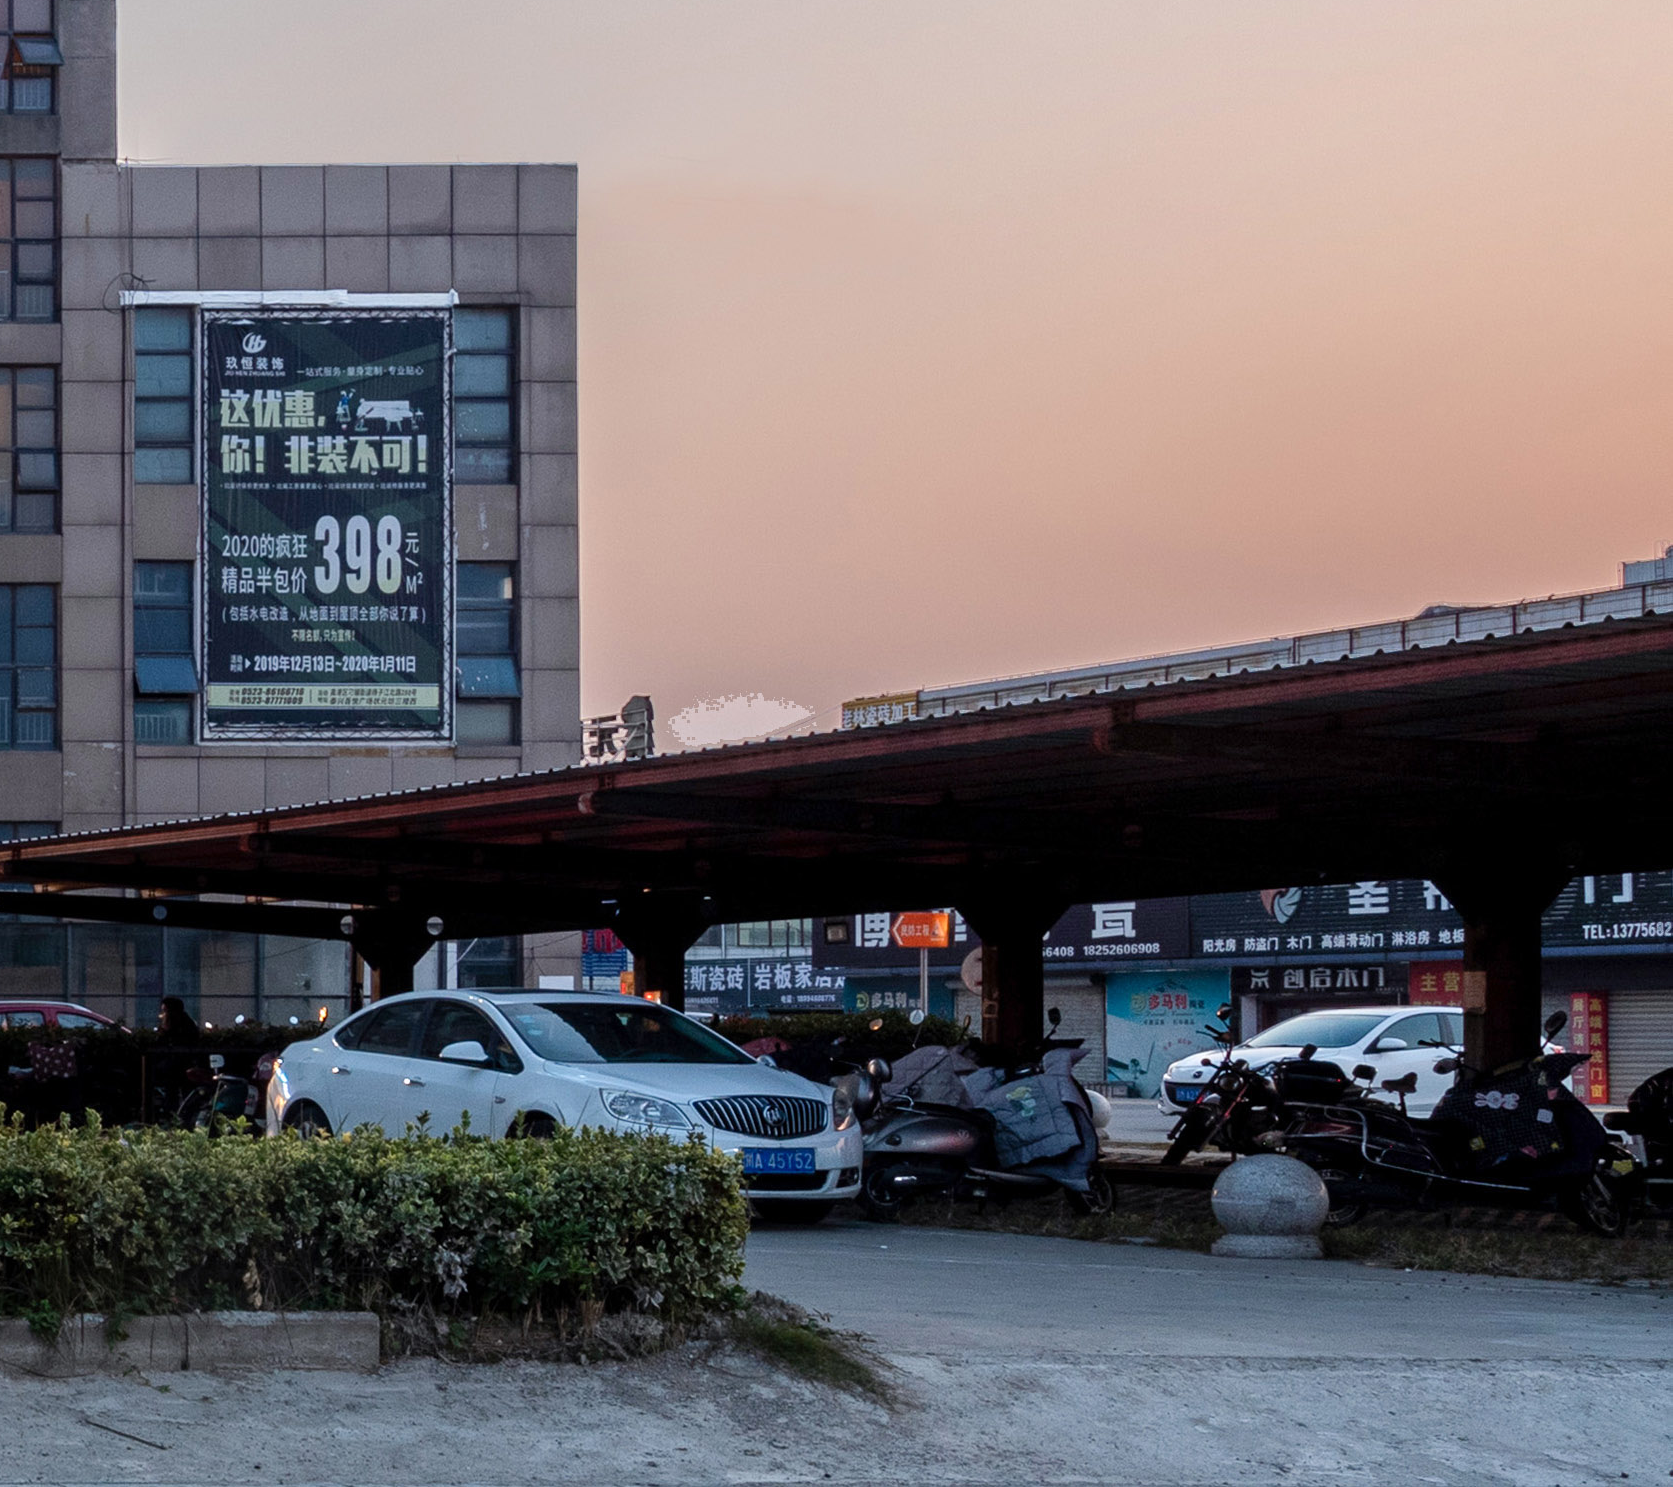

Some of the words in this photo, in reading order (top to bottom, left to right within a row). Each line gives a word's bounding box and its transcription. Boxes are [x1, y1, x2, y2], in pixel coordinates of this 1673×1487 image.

[226, 356, 285, 370] 玖恒装饰
[221, 533, 308, 559] 2020的疯狂
[314, 515, 402, 594] 398
[221, 567, 308, 595] 精品半包价
[253, 655, 417, 673] 2019年12月13日~2020年1月11日
[1083, 942, 1161, 957] 18252606908
[1202, 938, 1236, 953] 阳光房
[1244, 937, 1279, 953] 防盗门
[1286, 935, 1312, 951] 木门
[1321, 932, 1384, 949] 高端滑动门
[1391, 929, 1431, 947] 淋浴房
[684, 964, 744, 991] 斯瓷砖
[1283, 966, 1390, 989] 创启木门
[1420, 972, 1462, 993] 主营
[1572, 997, 1585, 1098] 展厅请二楼
